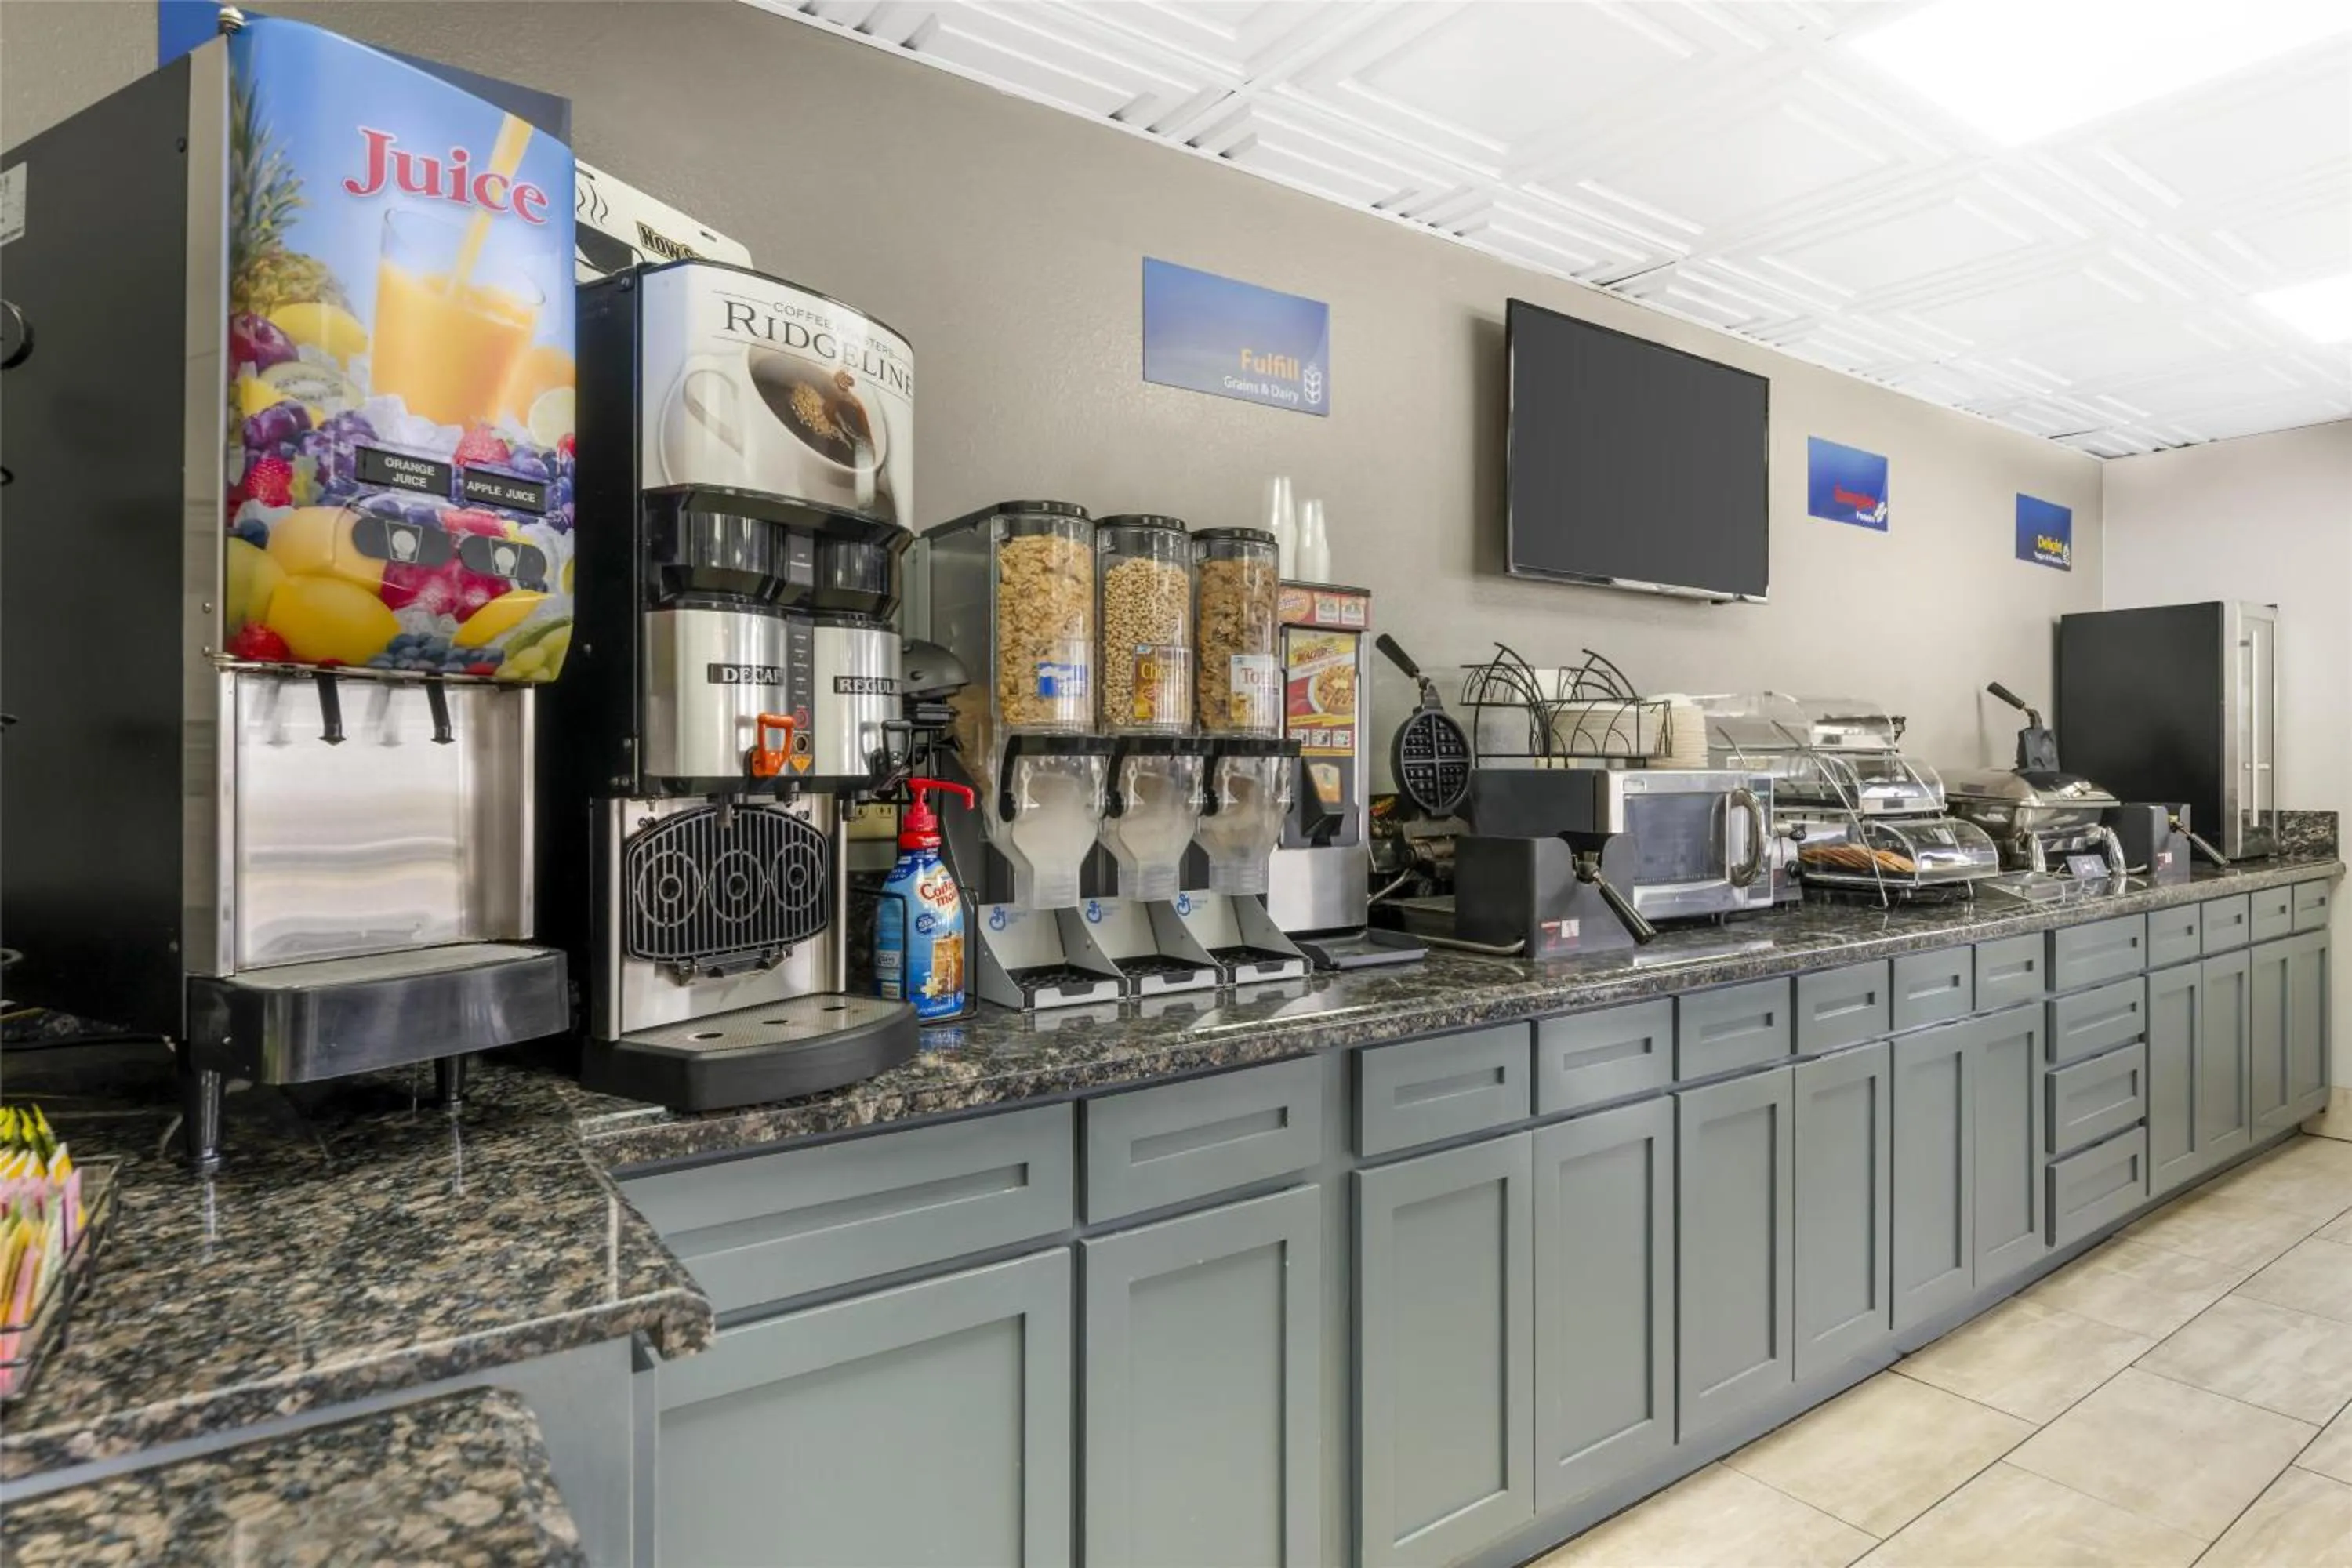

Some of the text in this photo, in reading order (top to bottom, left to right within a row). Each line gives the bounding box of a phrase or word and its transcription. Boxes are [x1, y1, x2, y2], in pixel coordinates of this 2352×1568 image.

[343, 126, 548, 225] Juice
[773, 302, 833, 330] COFFEE
[724, 300, 914, 397] RIDGELINE
[1241, 348, 1300, 381] Fulfill
[1224, 376, 1259, 394] Grains
[1271, 383, 1299, 405] Dairy
[384, 457, 435, 476] ORANGE
[393, 472, 427, 488] JUICE
[466, 481, 536, 503] APPLE JUICE
[722, 666, 781, 684] DECAF
[839, 678, 902, 696] REGUL
